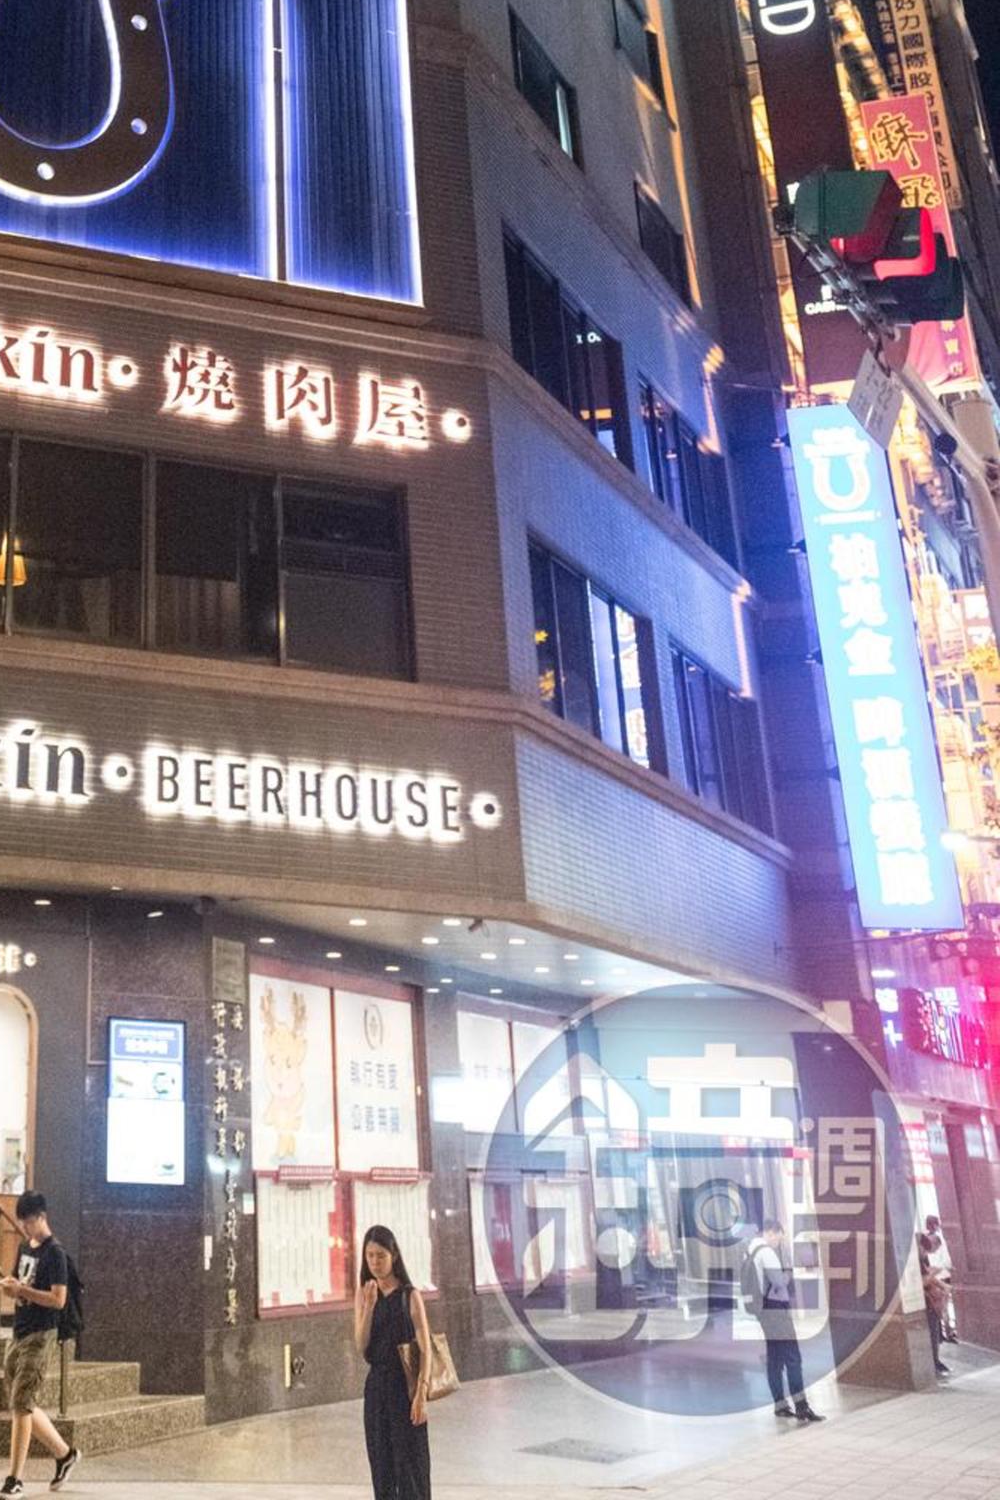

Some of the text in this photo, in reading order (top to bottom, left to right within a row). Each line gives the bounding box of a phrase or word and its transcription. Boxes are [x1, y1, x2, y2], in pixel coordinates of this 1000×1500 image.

[170, 346, 431, 443] 燒肉屋
[157, 754, 463, 833] BEERHOUSE
